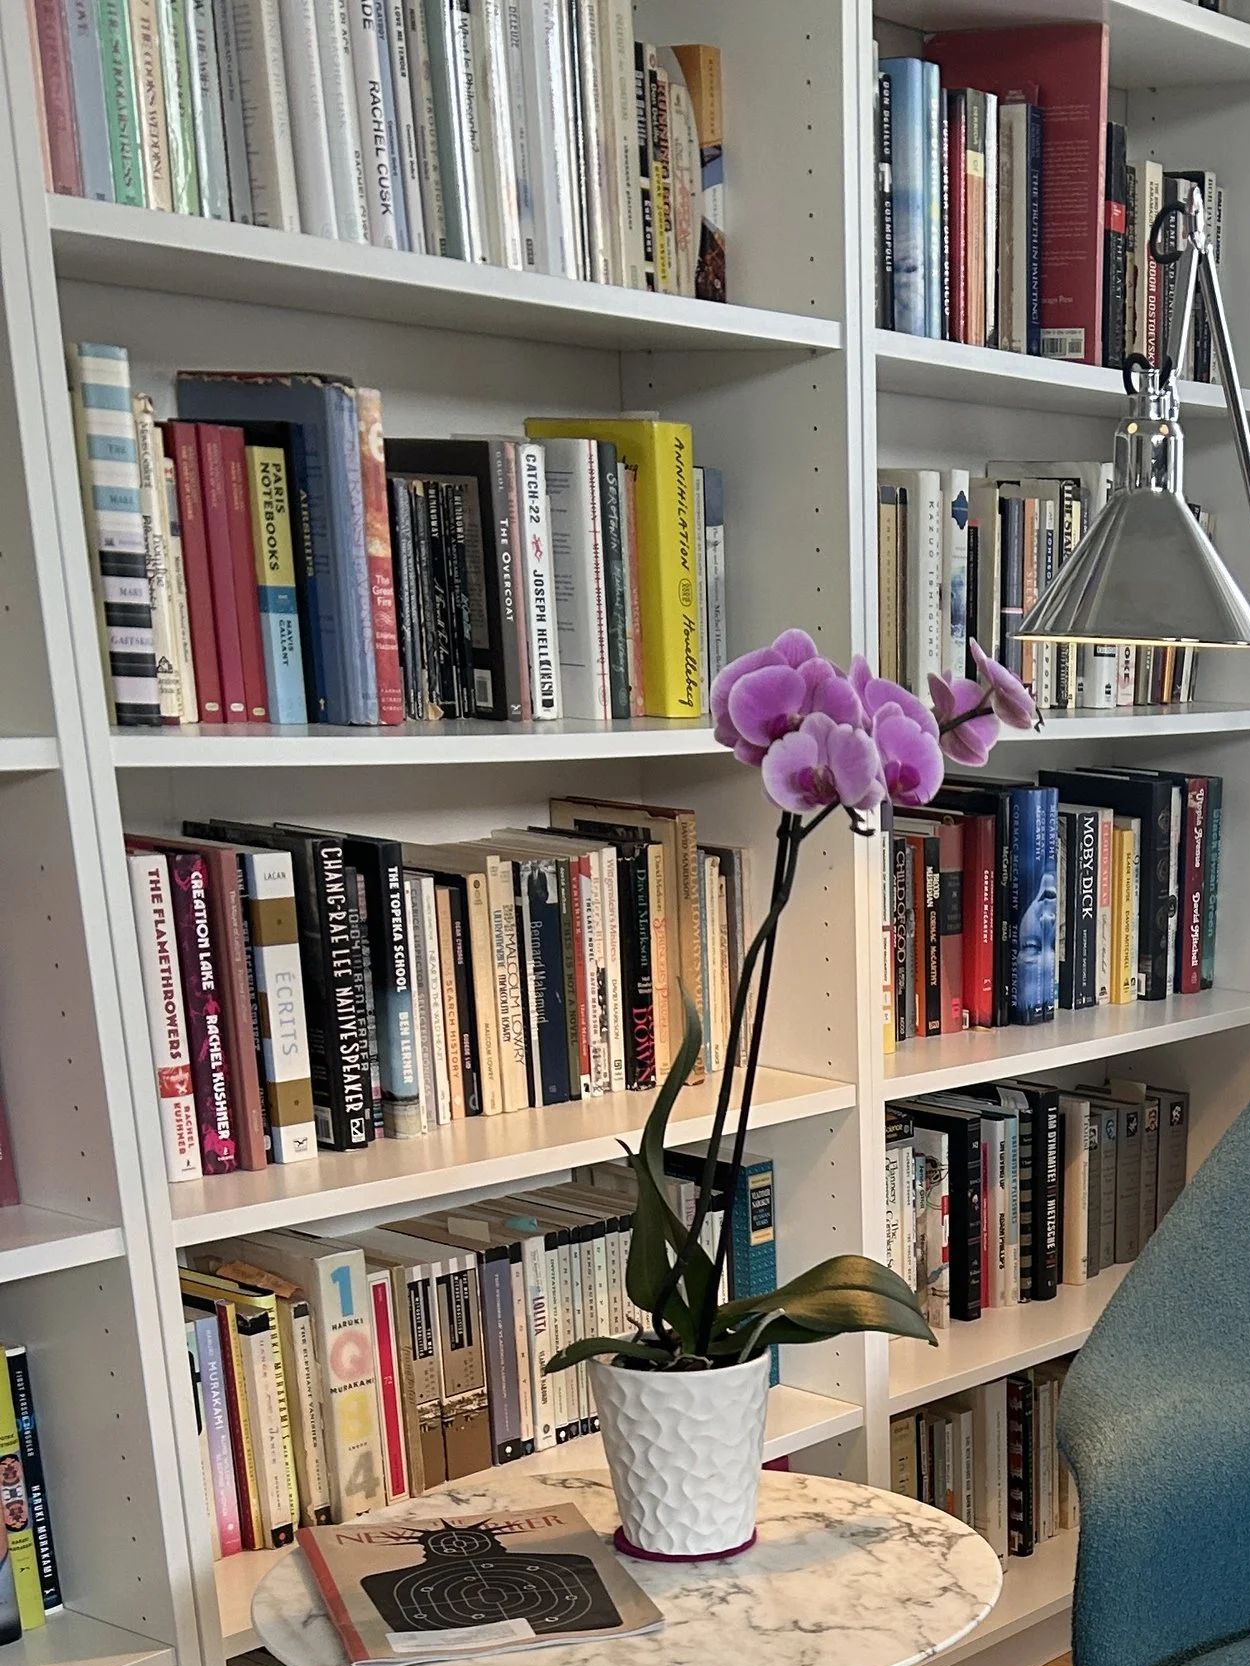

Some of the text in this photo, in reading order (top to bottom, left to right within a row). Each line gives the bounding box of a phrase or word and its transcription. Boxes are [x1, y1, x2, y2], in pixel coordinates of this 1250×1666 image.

[457, 18, 471, 45] What
[368, 80, 393, 216] RACHEL CUSK
[1147, 294, 1157, 369] DOSTOEVSKY
[259, 462, 280, 571] NOTEBOOKS
[271, 462, 286, 514] PARIS
[525, 453, 547, 623] CATCH-22 JOSEPH
[278, 620, 290, 666] GALLANT
[285, 620, 295, 652] MAVIS
[263, 871, 287, 882] LACAN
[982, 869, 990, 902] CORMAC
[1081, 815, 1095, 920] MOBY-DICK
[1190, 788, 1205, 967] Utopia Avenue David Mitchell
[635, 868, 650, 969] David Markson
[895, 850, 907, 963] CHILD OF GOD
[147, 868, 183, 1061] THE FLAMETHROWERS
[410, 888, 425, 989] CLARICE LISPECTOR
[320, 847, 364, 1113] CHANG-RAE LEE NATIVE SPEAKER
[388, 866, 414, 1084] THE TOPEKA SCHOOL BEN LERNER
[504, 932, 521, 1010] MALCOLM
[611, 978, 620, 1001] DAVID
[189, 870, 230, 1140] CREATION LAKE RACHEL KUSHNER
[274, 970, 298, 1057] ÉCRITS
[445, 980, 461, 1079] SEARCH HISTORY
[483, 1022, 492, 1055] MALCOLM
[173, 1102, 187, 1155] KUSHNER
[183, 1104, 195, 1149] RACHEL
[1047, 1114, 1057, 1130] AM
[917, 1164, 925, 1188] Jenny
[1046, 1131, 1058, 1182] DYNAMITE!
[1046, 1199, 1057, 1249] NIETZSCHE
[299, 1324, 308, 1345] THE
[331, 1317, 364, 1331] HARUKI
[532, 1295, 547, 1336] LOLITA
[207, 1360, 223, 1431] MURAKAMI
[344, 1450, 381, 1500] 4
[30, 1484, 53, 1578] HARUKI MURAKAMI
